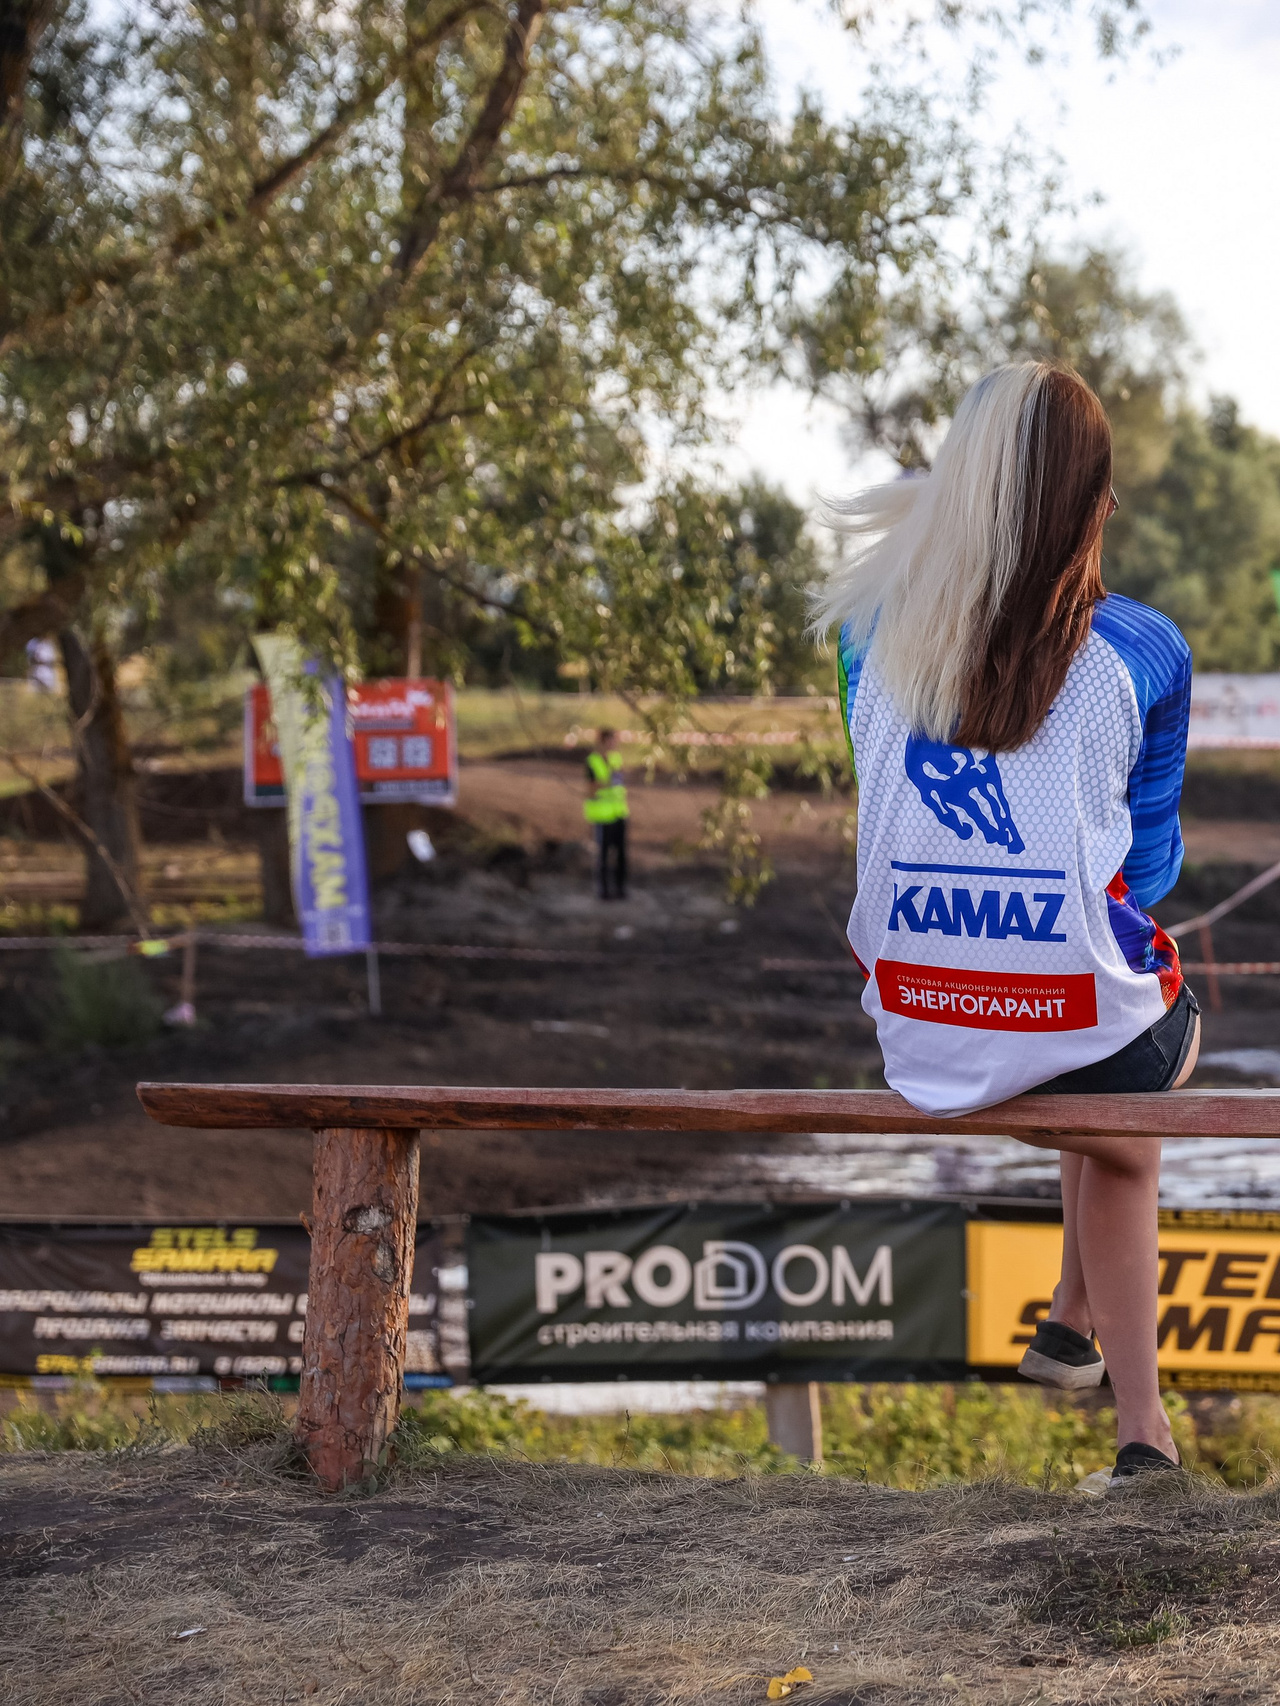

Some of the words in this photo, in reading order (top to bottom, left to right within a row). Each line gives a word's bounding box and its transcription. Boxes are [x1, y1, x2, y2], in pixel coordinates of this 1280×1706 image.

[888, 883, 1067, 942] KAMAZ
[897, 974, 942, 988] СТРАХОВАЯ
[945, 982, 1009, 994] АКЦИОНЕРНАЯ
[1012, 987, 1066, 995] КОМПАНИЯ
[898, 985, 1066, 1018] ЭНЕРГОГАРАНТ
[149, 1228, 259, 1248] STELS
[130, 1248, 279, 1273] SAMARA
[0, 1289, 149, 1313] ВАДРОЦИКЛЫ
[151, 1292, 295, 1315] МОТОЦИКЛЫ
[33, 1317, 151, 1340] ПРОДАЖА
[161, 1319, 278, 1341] ЗАПЧАСТИ
[537, 1319, 739, 1348] строительная
[745, 1319, 895, 1342] компания
